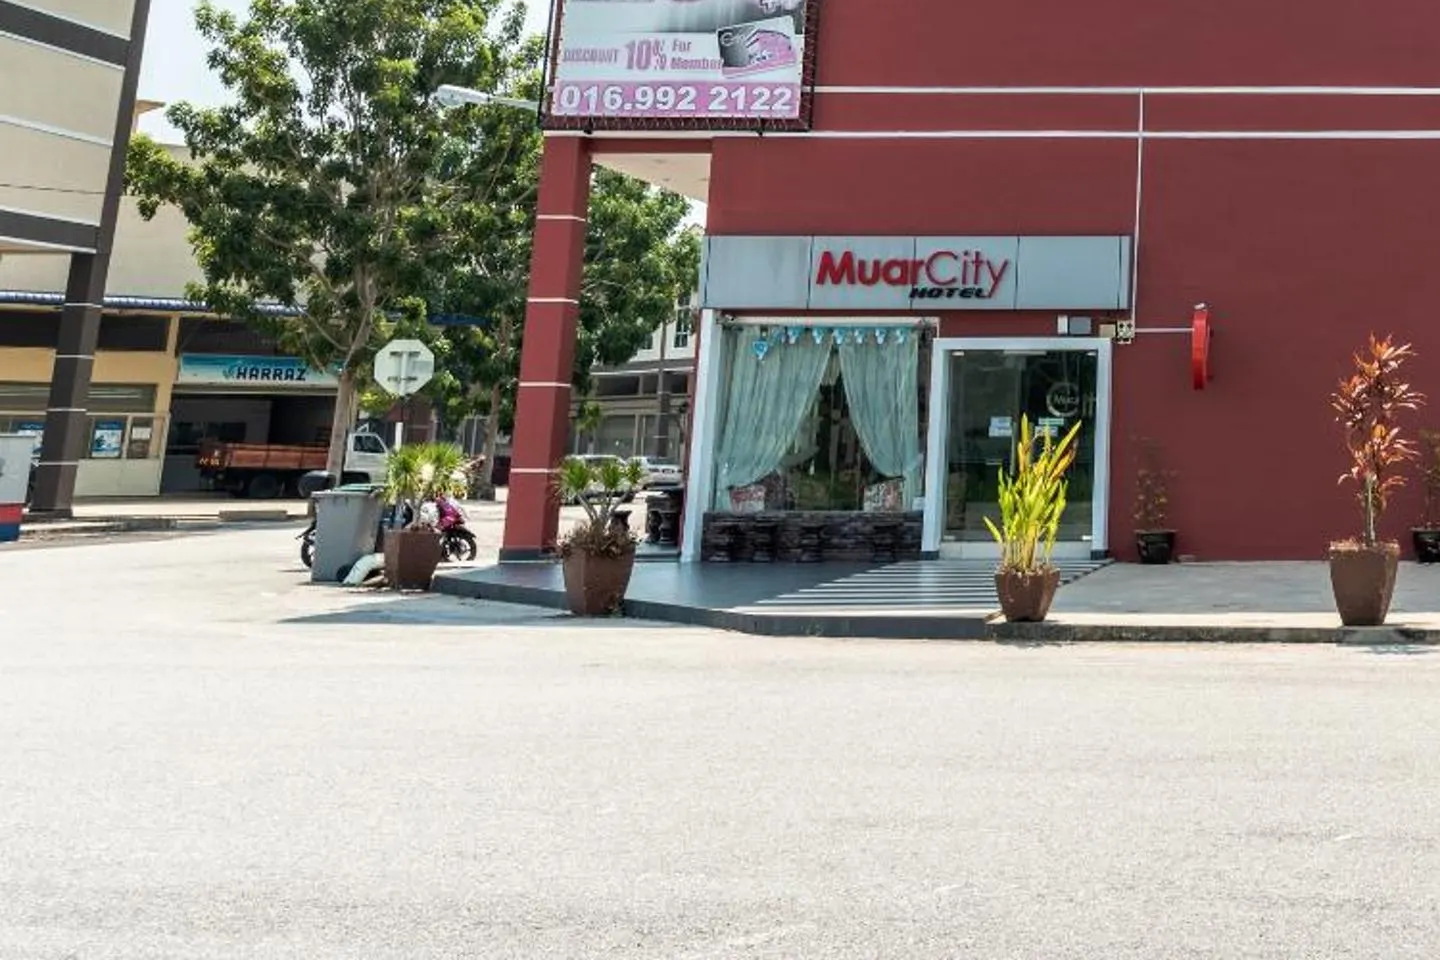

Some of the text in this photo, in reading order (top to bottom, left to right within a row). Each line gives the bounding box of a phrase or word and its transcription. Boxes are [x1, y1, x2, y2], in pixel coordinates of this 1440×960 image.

[625, 38, 668, 71] 10%
[671, 39, 693, 53] For
[559, 85, 793, 112] 016.992 2122
[815, 250, 1009, 299] MuarCity
[908, 286, 990, 299] HOTEL
[235, 366, 307, 382] HARRAZ
